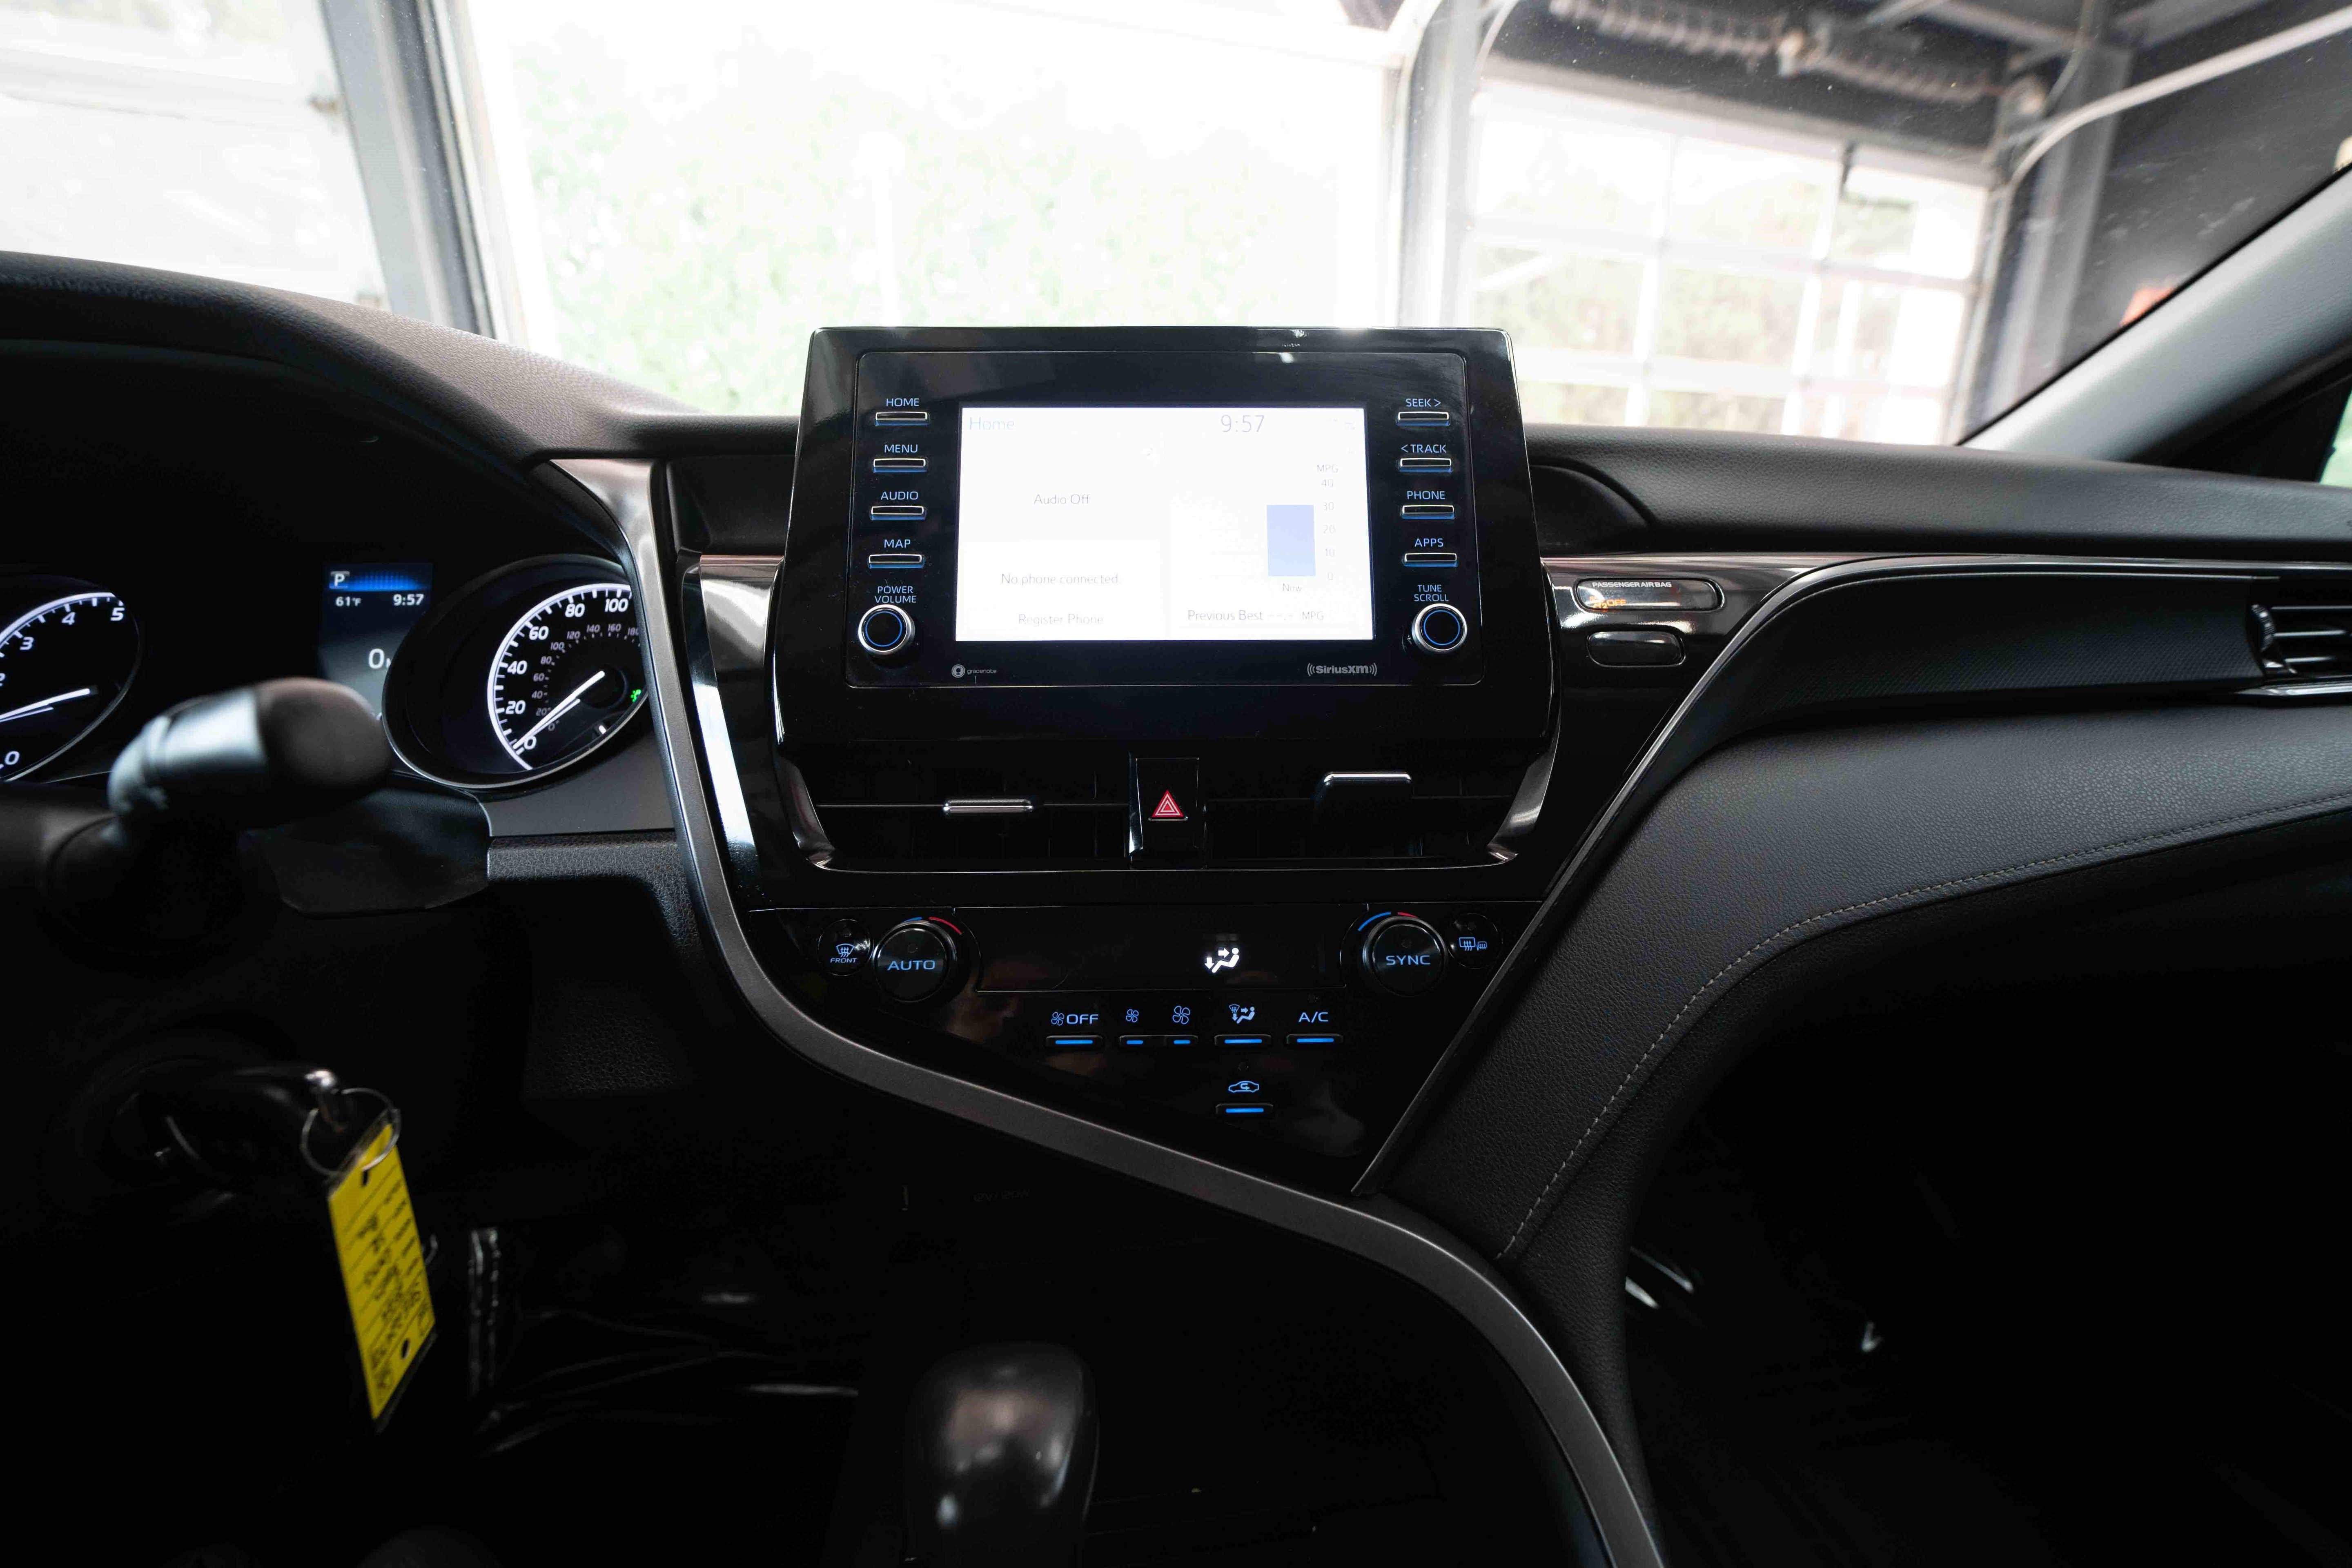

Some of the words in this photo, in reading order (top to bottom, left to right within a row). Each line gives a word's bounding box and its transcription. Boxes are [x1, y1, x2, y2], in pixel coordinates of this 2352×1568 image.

[886, 398, 919, 407] HOME
[969, 417, 1015, 430] Home
[1221, 414, 1265, 432] 9:57
[884, 444, 918, 453] MENU
[1317, 464, 1338, 473] MPG
[1321, 479, 1334, 488] 40
[881, 492, 918, 500] AUDIO
[1033, 494, 1067, 505] Audio
[1070, 494, 1091, 505] Off
[1407, 491, 1445, 499] PHONE
[1323, 502, 1334, 511] 30
[1323, 525, 1335, 534] 20
[884, 539, 911, 548] MAP
[1414, 538, 1443, 547] APPS
[1325, 548, 1335, 557] 10
[334, 574, 345, 587] P
[1001, 573, 1018, 585] No
[1022, 573, 1056, 587] phone
[878, 586, 913, 594] POWER
[393, 594, 424, 606] 9:57
[1414, 594, 1449, 602] SCROLL
[565, 603, 585, 617] 80
[605, 598, 629, 612] 100
[62, 612, 76, 625] 4
[111, 608, 125, 621] 5
[1019, 614, 1063, 626] Register
[1068, 614, 1104, 625] Phone
[1187, 610, 1235, 621] Previous
[1238, 610, 1263, 621] Best
[1302, 610, 1324, 620] MPG
[529, 626, 549, 640] 60
[586, 624, 600, 633] 140
[608, 624, 621, 632] 160
[20, 637, 34, 650] 3
[551, 642, 565, 650] 100
[541, 656, 552, 665] 80
[507, 660, 528, 674] 40
[533, 673, 544, 682] 60
[506, 700, 526, 714] 20
[523, 735, 537, 750] 0
[4, 751, 20, 765] 0
[887, 960, 935, 971] AUTO
[1385, 955, 1431, 965] SYNC
[1066, 1014, 1099, 1025] OFF
[1298, 1011, 1329, 1023] A/C
